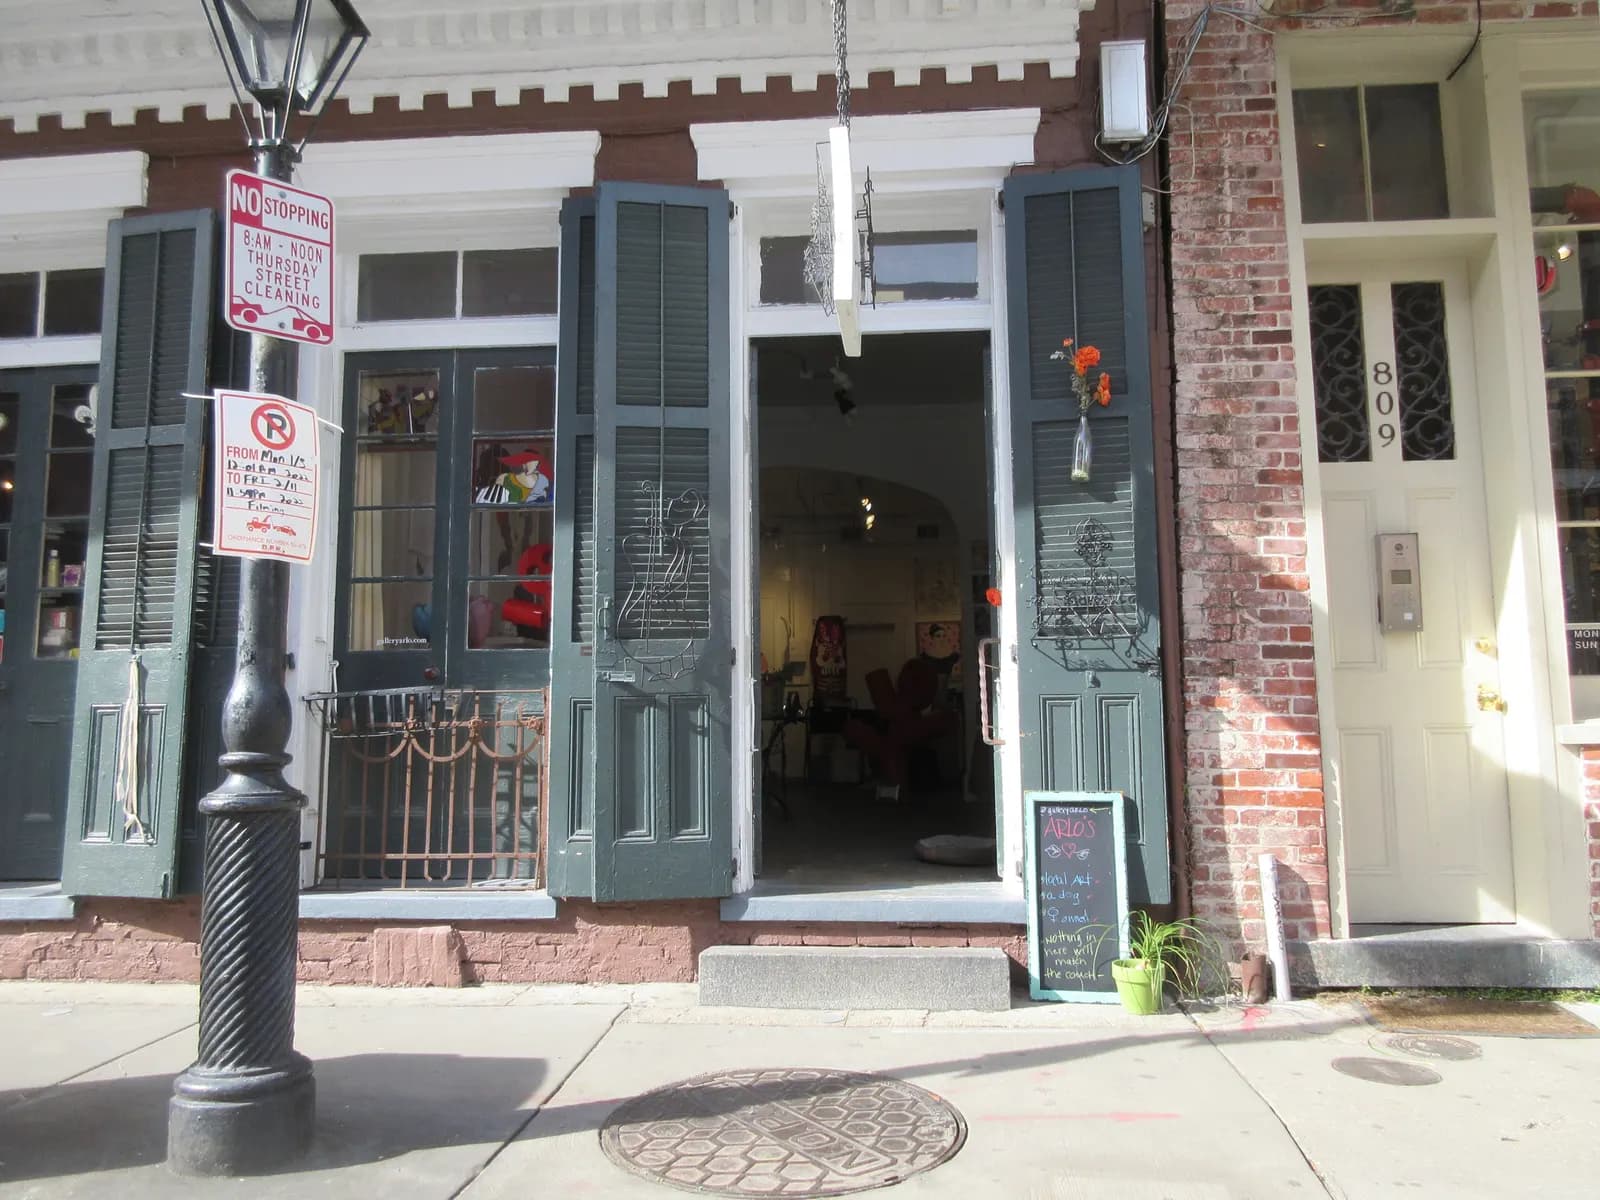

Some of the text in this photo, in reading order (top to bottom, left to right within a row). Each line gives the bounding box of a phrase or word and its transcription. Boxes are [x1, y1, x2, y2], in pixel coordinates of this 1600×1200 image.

[232, 183, 329, 230] NO STOPPING
[290, 242, 322, 264] NOON
[248, 249, 318, 278] THURSDAY
[256, 268, 310, 292] STREET
[244, 281, 320, 309] CLEANING
[1372, 361, 1396, 448] 809
[226, 445, 259, 461] FROM
[226, 471, 241, 485] TO
[1574, 630, 1599, 638] MON
[1575, 640, 1597, 649] SUN
[1086, 931, 1097, 943] in
[1055, 957, 1087, 966] match
